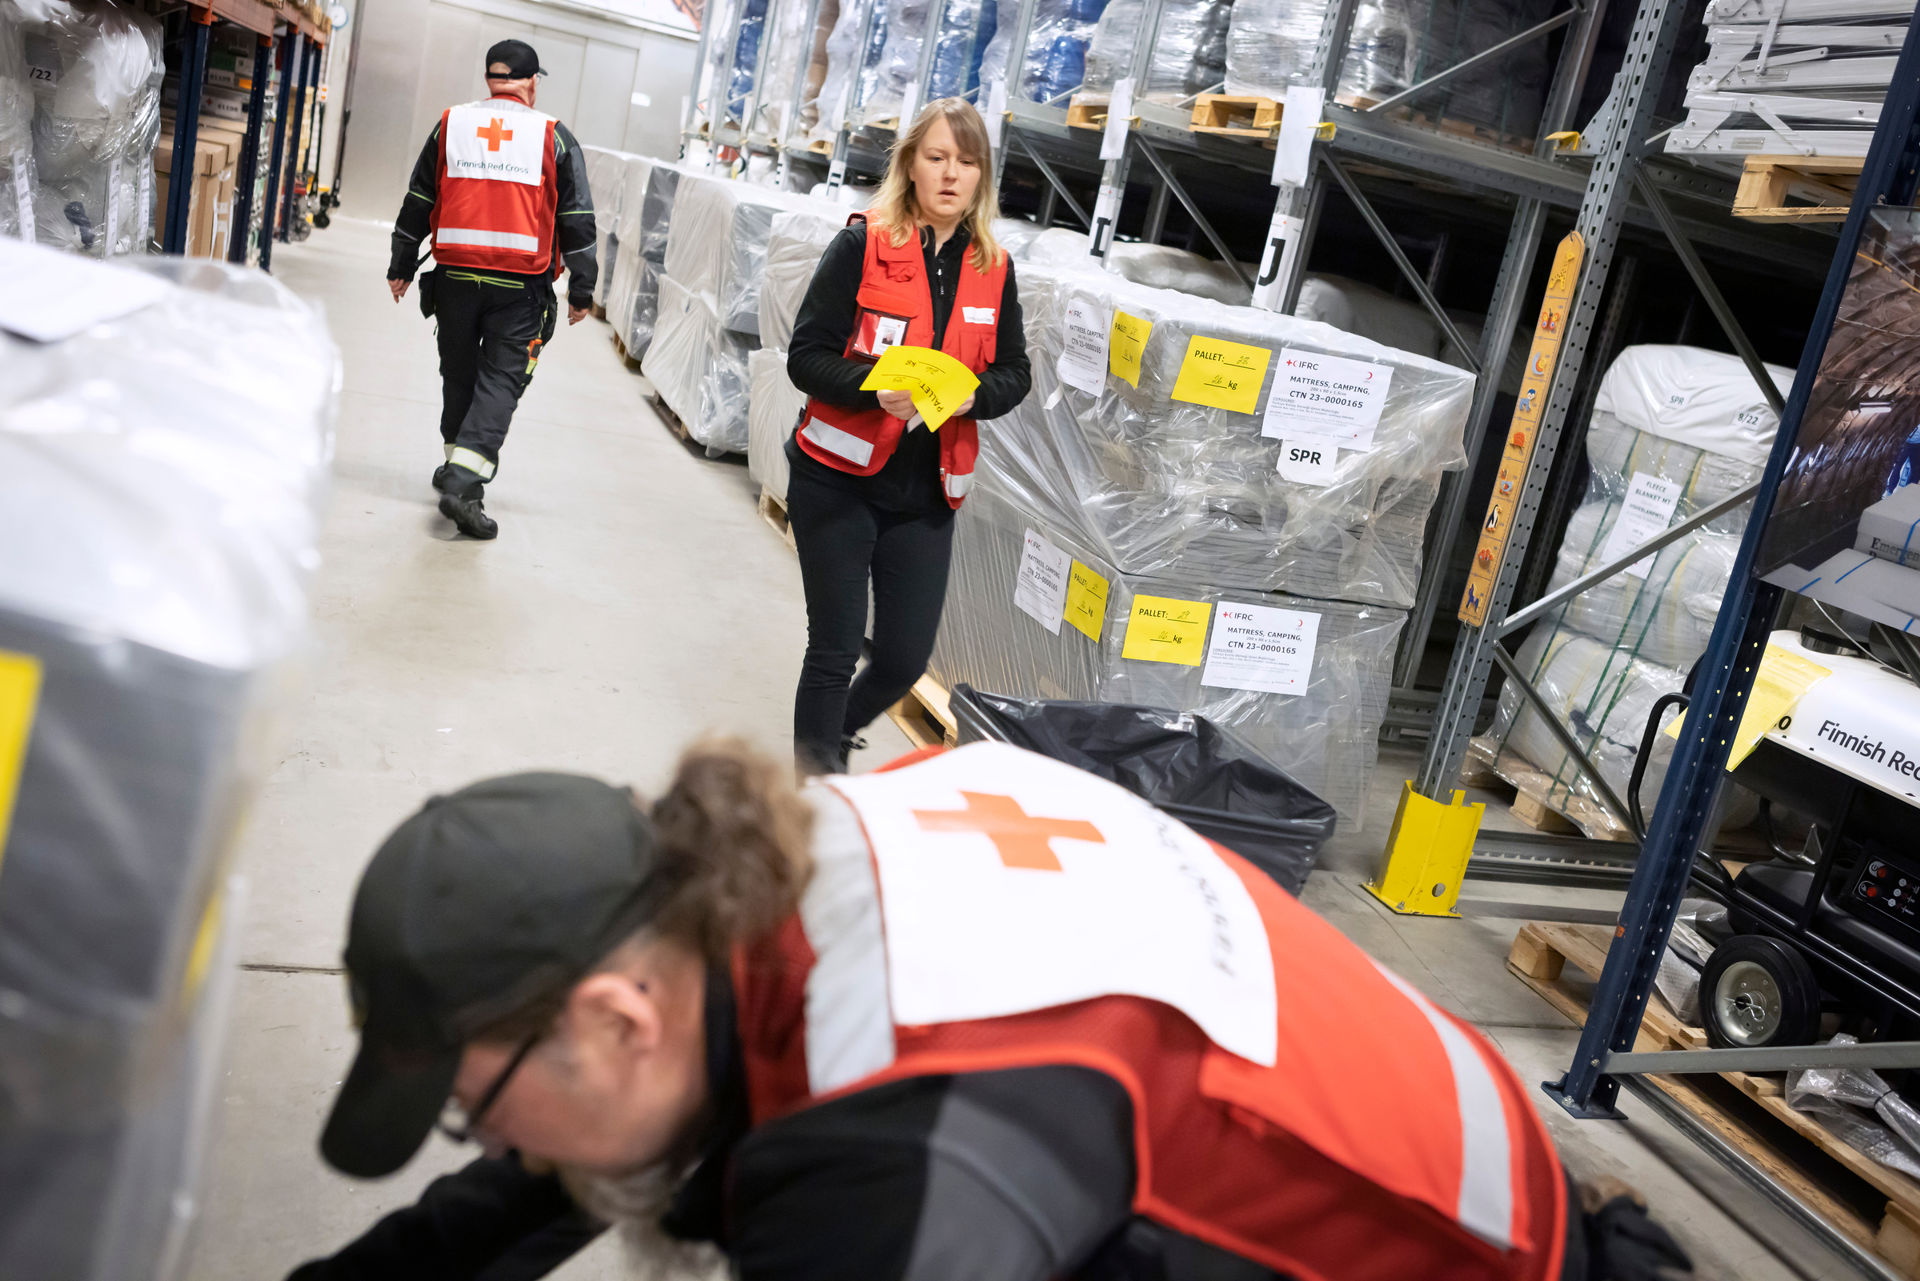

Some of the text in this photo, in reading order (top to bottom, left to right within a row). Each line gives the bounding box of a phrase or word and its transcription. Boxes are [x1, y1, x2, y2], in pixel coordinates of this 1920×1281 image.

[456, 159, 529, 174] Finnish Red Cross
[1258, 237, 1287, 287] J
[1194, 349, 1225, 362] PALLET:
[1299, 361, 1319, 371] IFRC
[1227, 380, 1238, 390] kg
[1290, 376, 1370, 395] MATTRESS, CAMPING,
[1289, 390, 1363, 409] CTN 23-0000165
[1289, 448, 1322, 465] SPR
[1646, 481, 1667, 493] FLEECE
[1635, 489, 1661, 502] BLANKET
[1138, 608, 1169, 619] PALLET:
[1234, 612, 1253, 621] IFRC
[1172, 634, 1183, 644] kg
[1227, 627, 1265, 637] MATTRESS,
[1267, 631, 1302, 642] CAMPING,
[1228, 641, 1296, 655] CTN 23-0000165
[1817, 719, 1886, 763] Finnish
